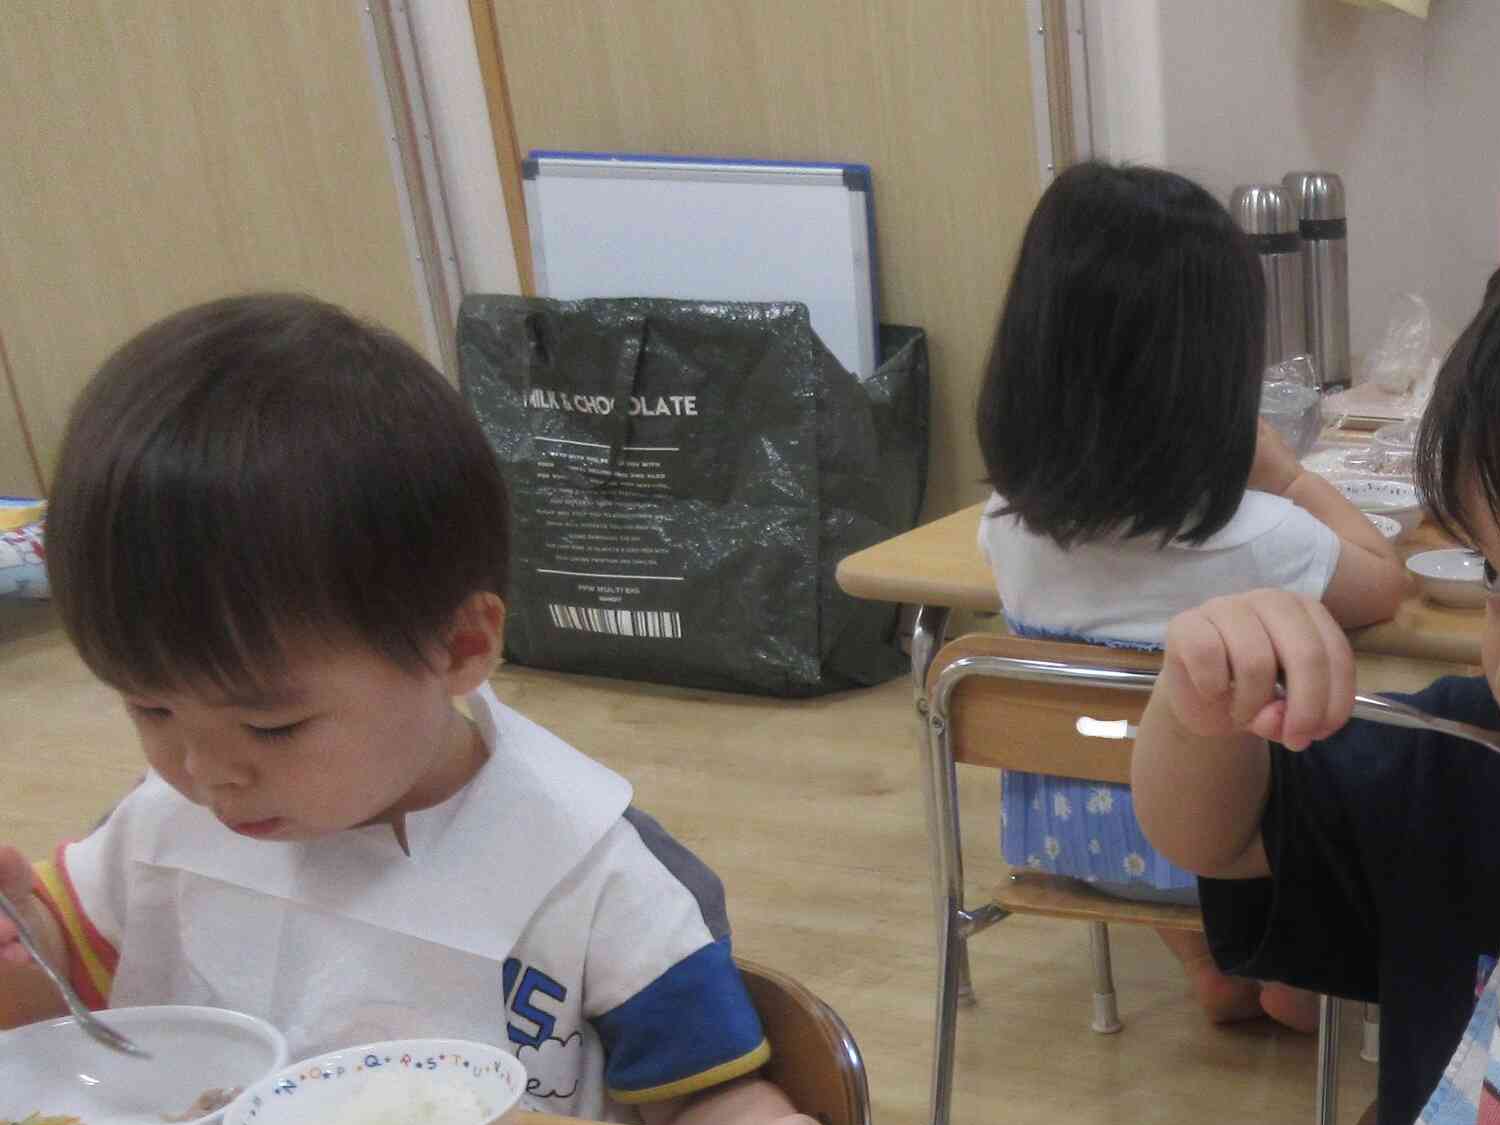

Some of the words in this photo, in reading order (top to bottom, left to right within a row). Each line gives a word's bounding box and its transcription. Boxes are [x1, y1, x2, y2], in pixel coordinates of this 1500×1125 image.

[574, 395, 698, 416] CHOOLATE
[364, 1054, 383, 1068] Q
[426, 1057, 437, 1070] S
